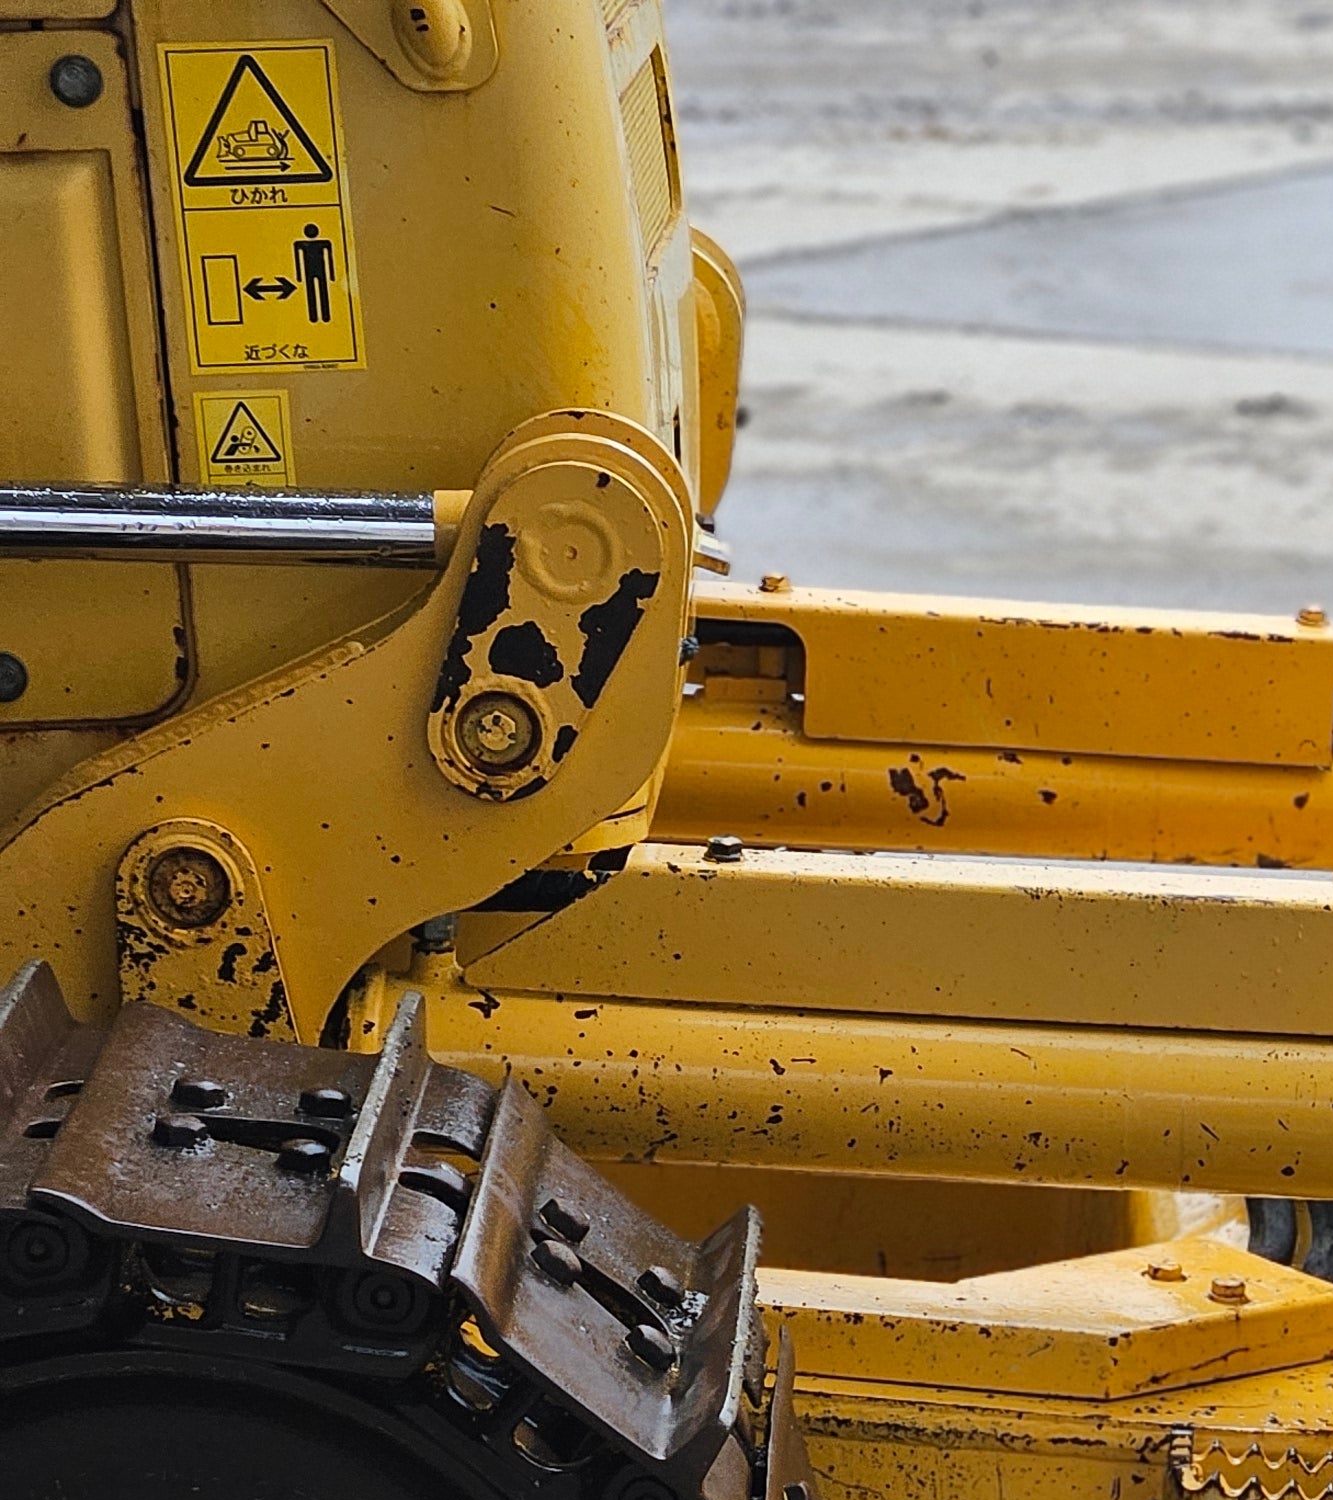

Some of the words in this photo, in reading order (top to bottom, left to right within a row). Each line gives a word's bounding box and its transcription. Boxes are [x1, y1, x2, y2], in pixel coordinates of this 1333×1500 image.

[229, 186, 288, 205] ひかれ
[244, 343, 309, 361] 近づくな
